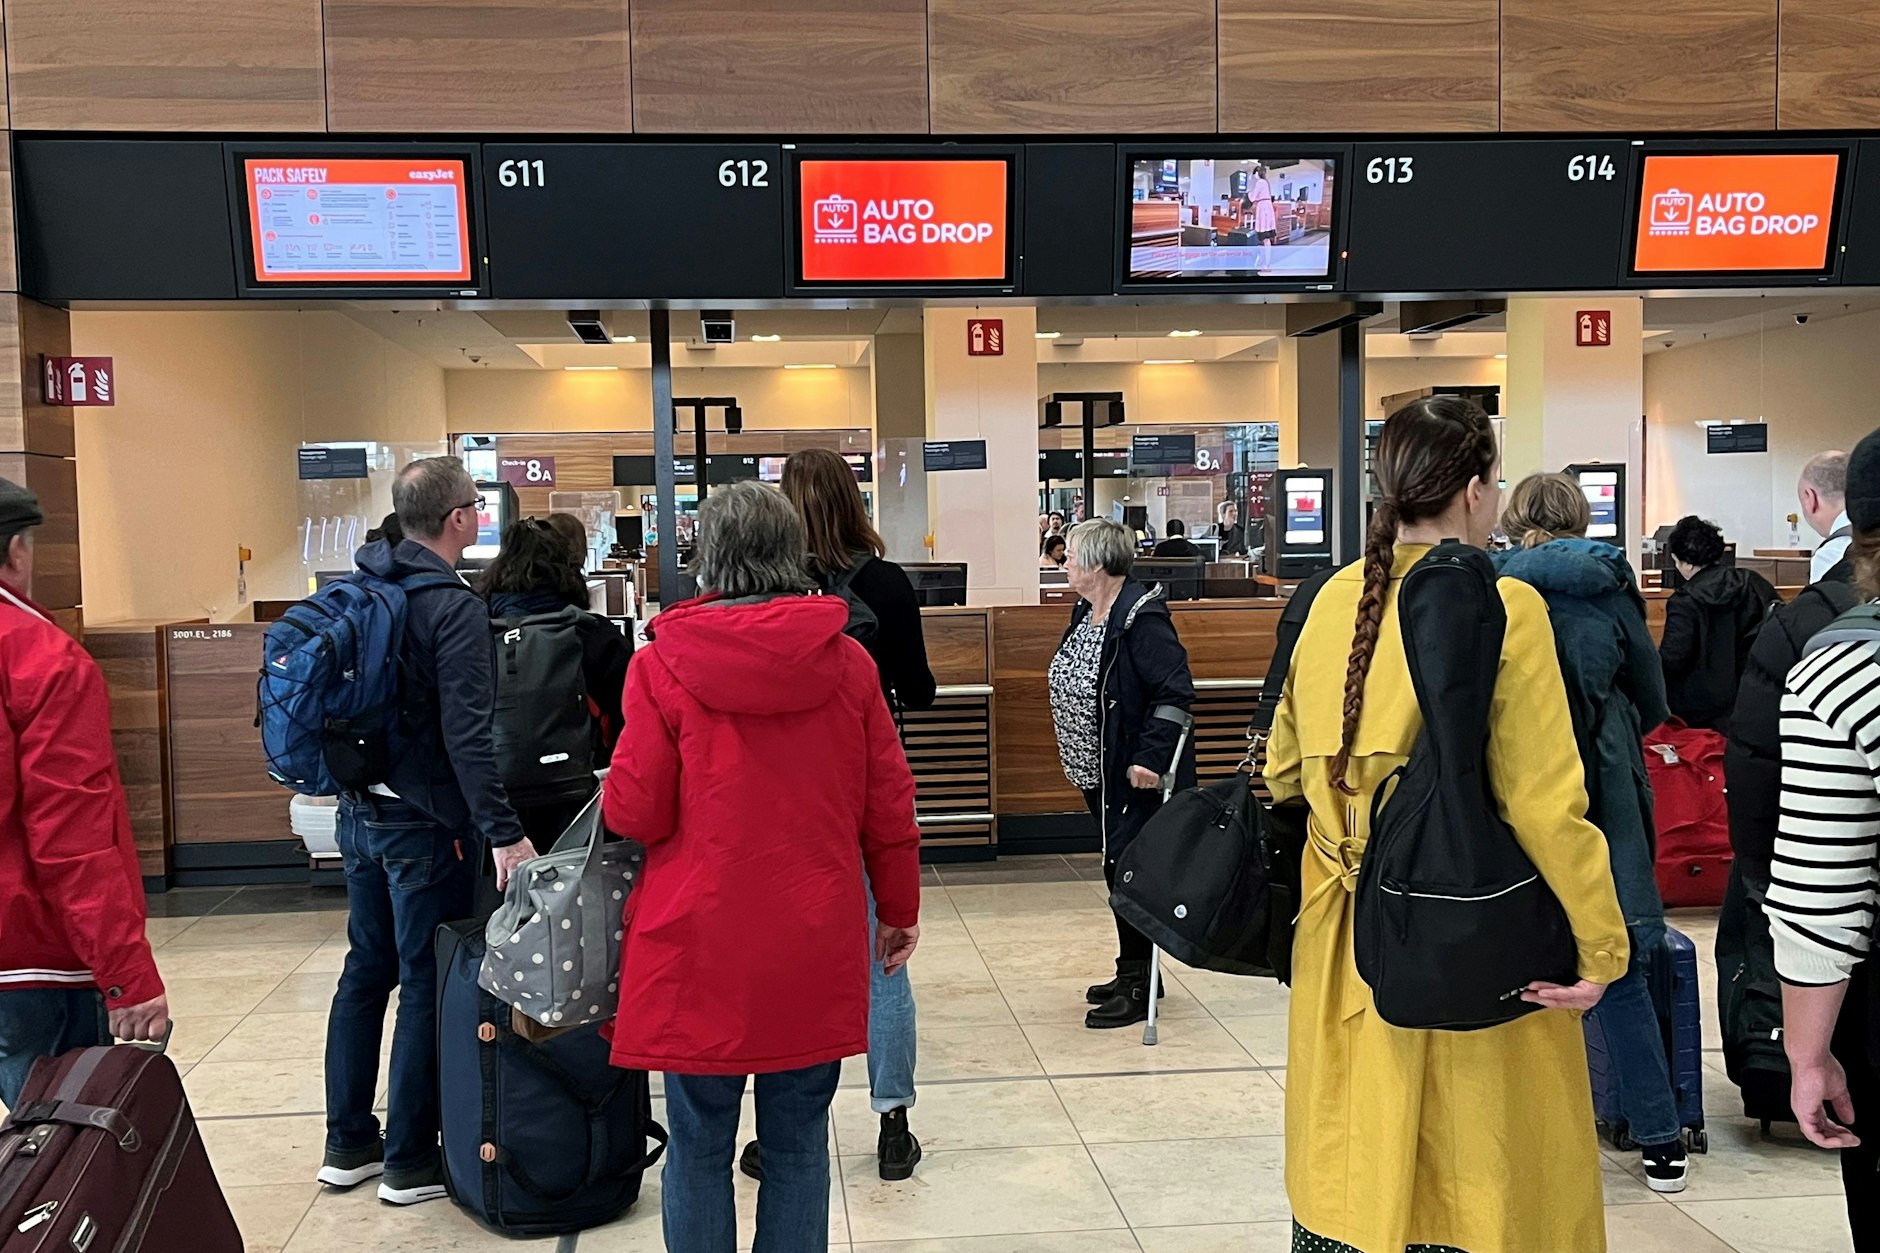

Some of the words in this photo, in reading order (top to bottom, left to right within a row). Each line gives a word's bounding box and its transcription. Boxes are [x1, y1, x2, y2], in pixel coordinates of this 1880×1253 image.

[254, 167, 285, 183] PACK
[286, 167, 327, 183] SAFELY
[408, 168, 454, 181] easyJet
[499, 160, 545, 187] 611
[718, 160, 769, 187] 612
[1366, 157, 1414, 184] 613
[1567, 155, 1616, 181] 614
[822, 203, 850, 213] AUTO
[862, 199, 934, 220] AUTO
[1659, 197, 1686, 206] AUTO
[1696, 192, 1765, 213] AUTO
[863, 223, 917, 244] BAG
[922, 222, 993, 243] DROP
[1695, 215, 1746, 235] BAG
[1750, 214, 1819, 235] DROP
[501, 459, 526, 467] Check-in
